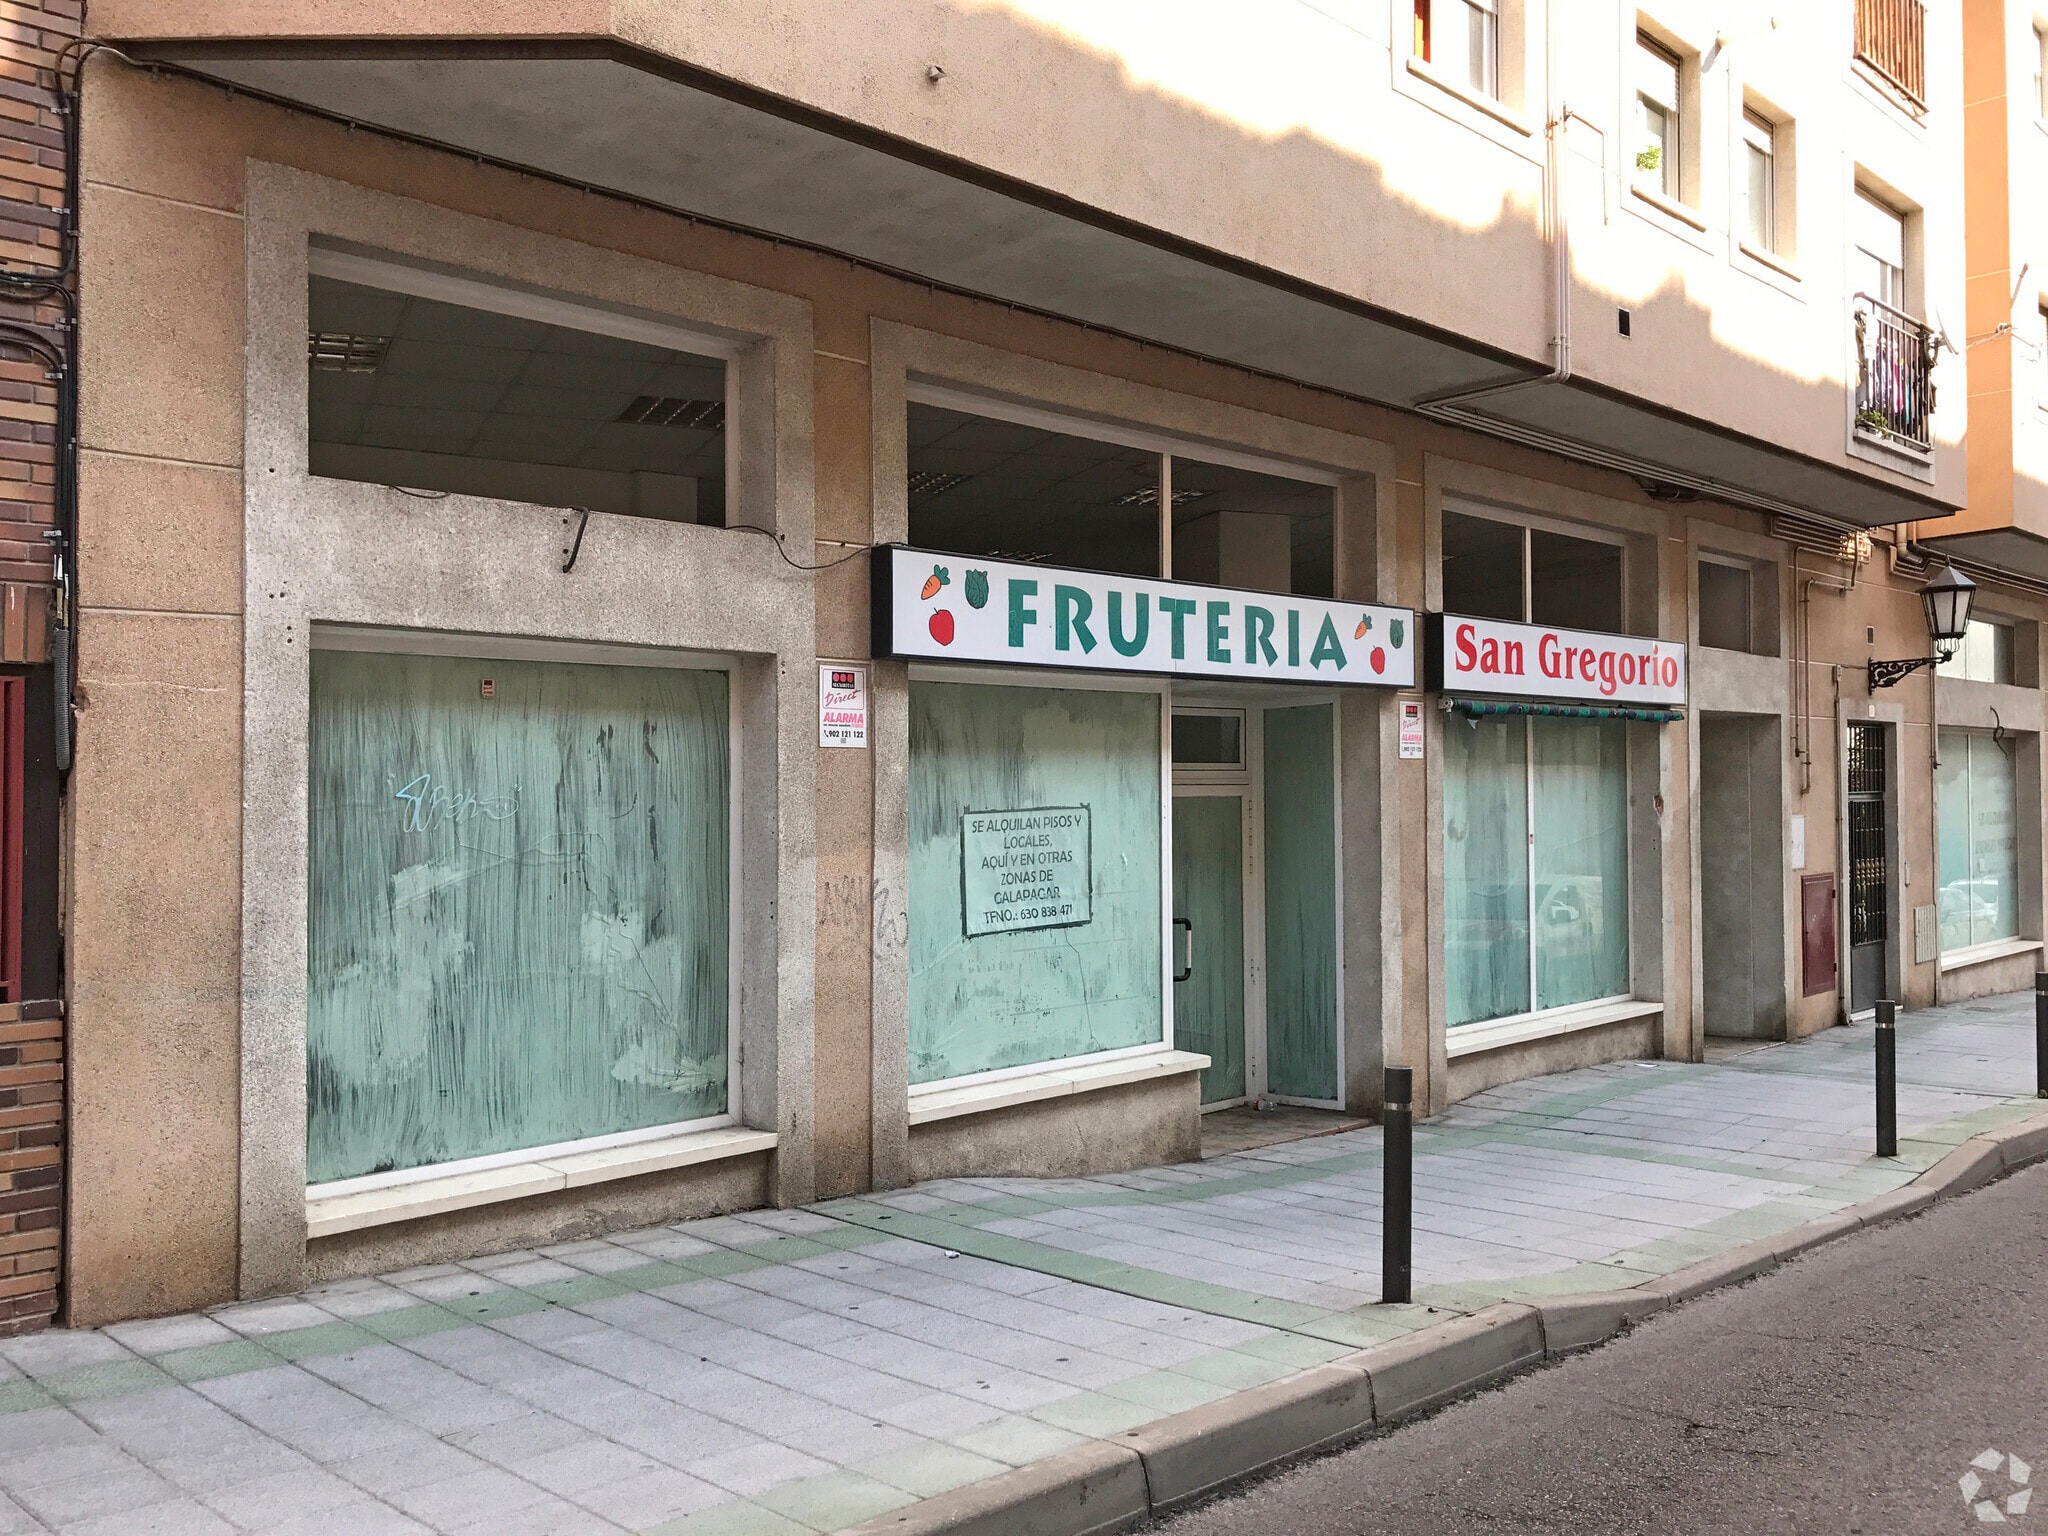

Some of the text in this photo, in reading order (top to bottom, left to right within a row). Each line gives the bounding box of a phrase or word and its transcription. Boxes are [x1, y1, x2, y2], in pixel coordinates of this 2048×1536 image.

[1008, 578, 1347, 671] FRUTERIA
[1455, 624, 1678, 696] San Gregorio
[825, 689, 861, 707] Direct
[824, 712, 864, 723] ALARMA
[829, 730, 839, 738] 902
[841, 730, 851, 738] 121
[972, 815, 1082, 833] SE ALQUILAN PISOS Y
[981, 850, 1073, 870] AQUÍ Y EN OTRAS
[1001, 869, 1054, 886] ZONAS DE
[983, 904, 1072, 925] TFNO.: 630 838 471
